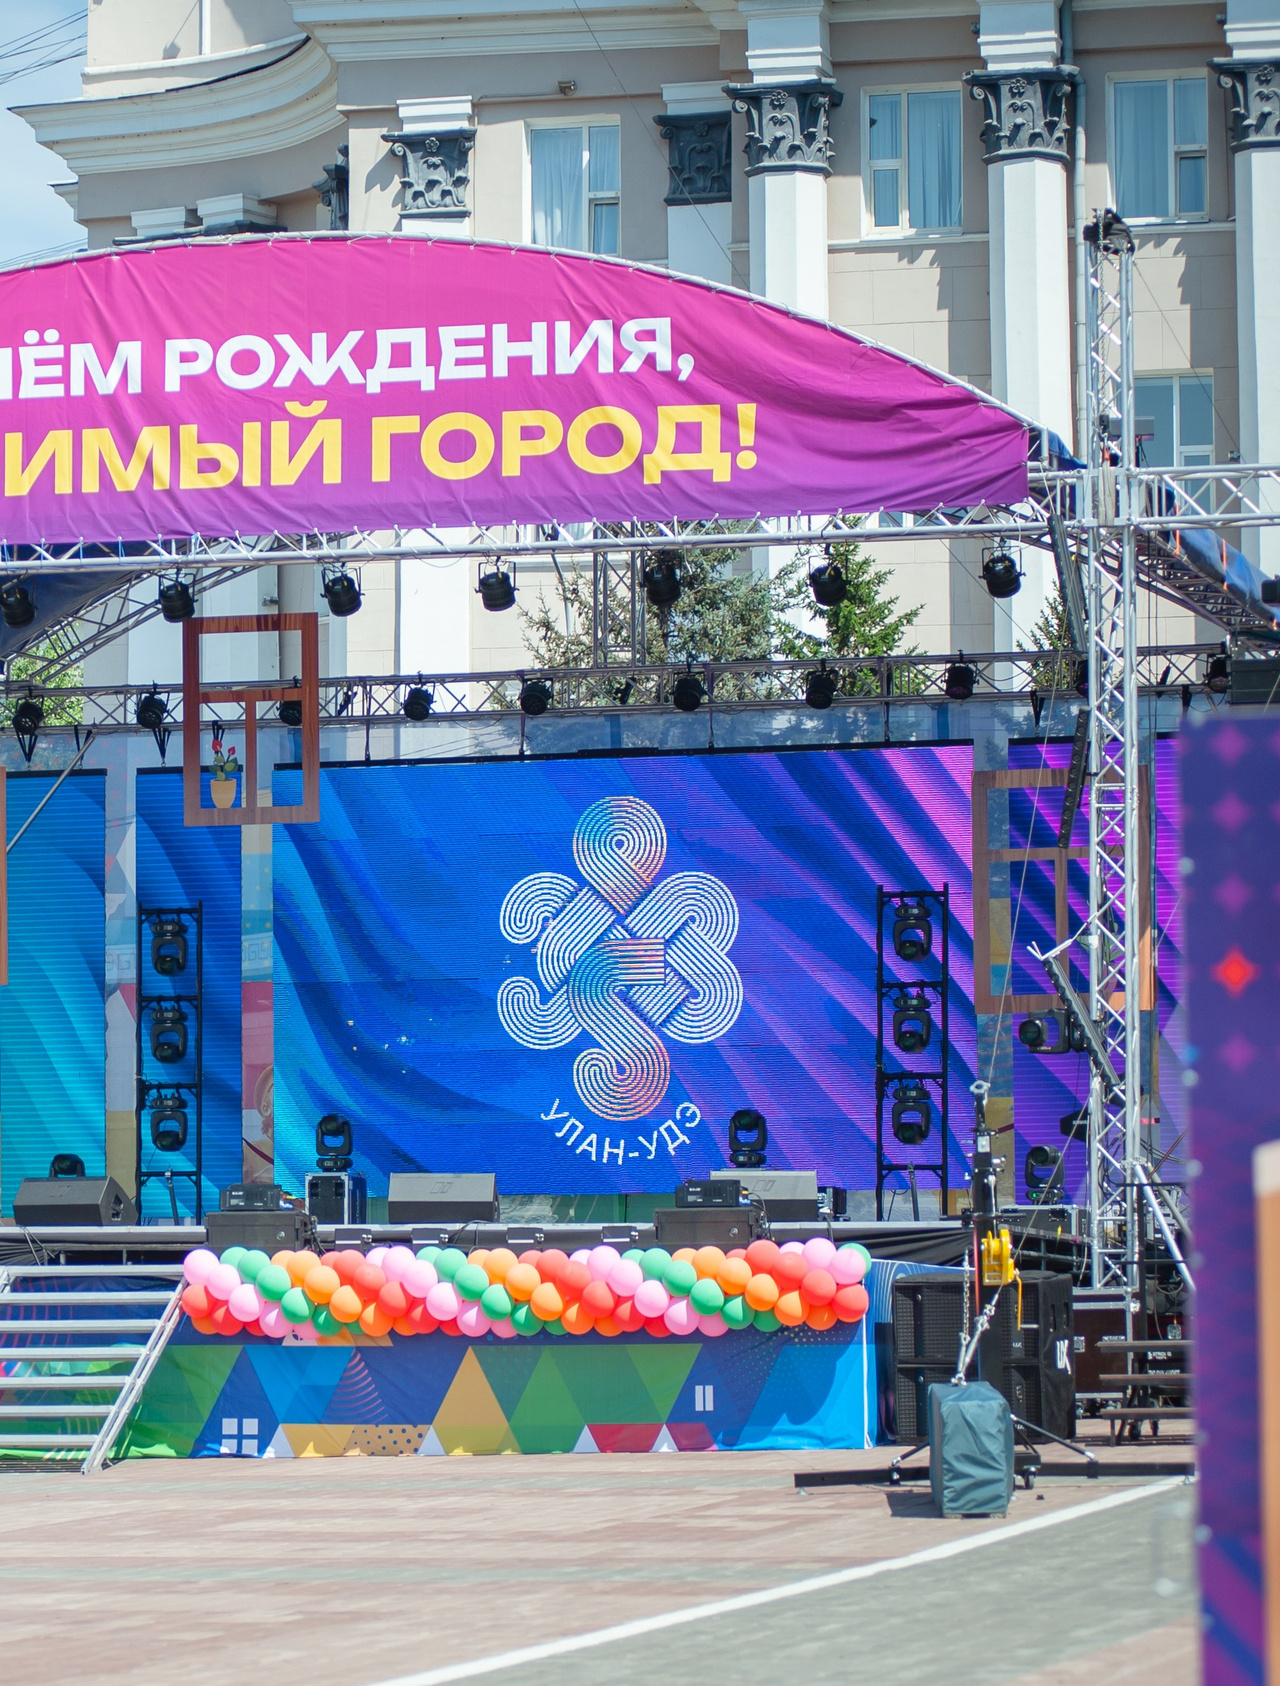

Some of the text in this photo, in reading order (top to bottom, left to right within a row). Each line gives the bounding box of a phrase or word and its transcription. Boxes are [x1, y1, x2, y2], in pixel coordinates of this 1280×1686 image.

[164, 316, 695, 394] РОЖДЕНИЯ,
[371, 403, 758, 484] ГОРОД!
[540, 1098, 702, 1165] УЛАН-УДЭ
